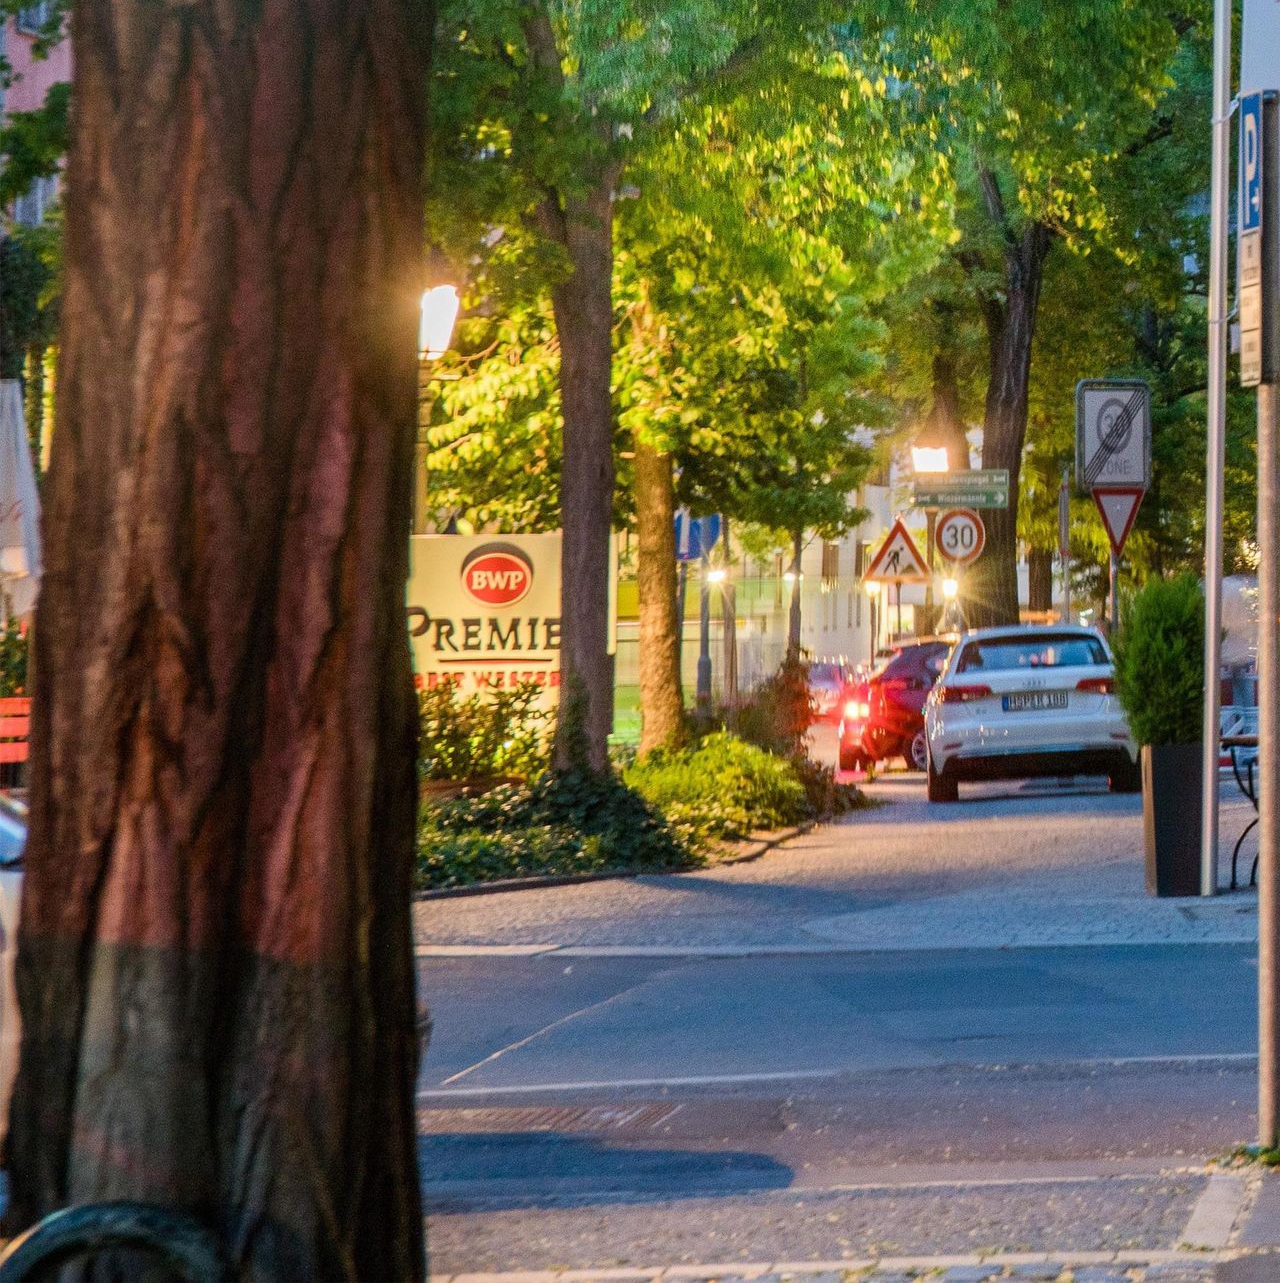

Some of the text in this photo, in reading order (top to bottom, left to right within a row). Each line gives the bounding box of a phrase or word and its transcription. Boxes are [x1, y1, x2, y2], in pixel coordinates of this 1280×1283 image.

[946, 523, 974, 549] 30
[471, 570, 524, 591] BWP
[405, 606, 561, 652] PREMIE
[473, 671, 561, 689] WESTER
